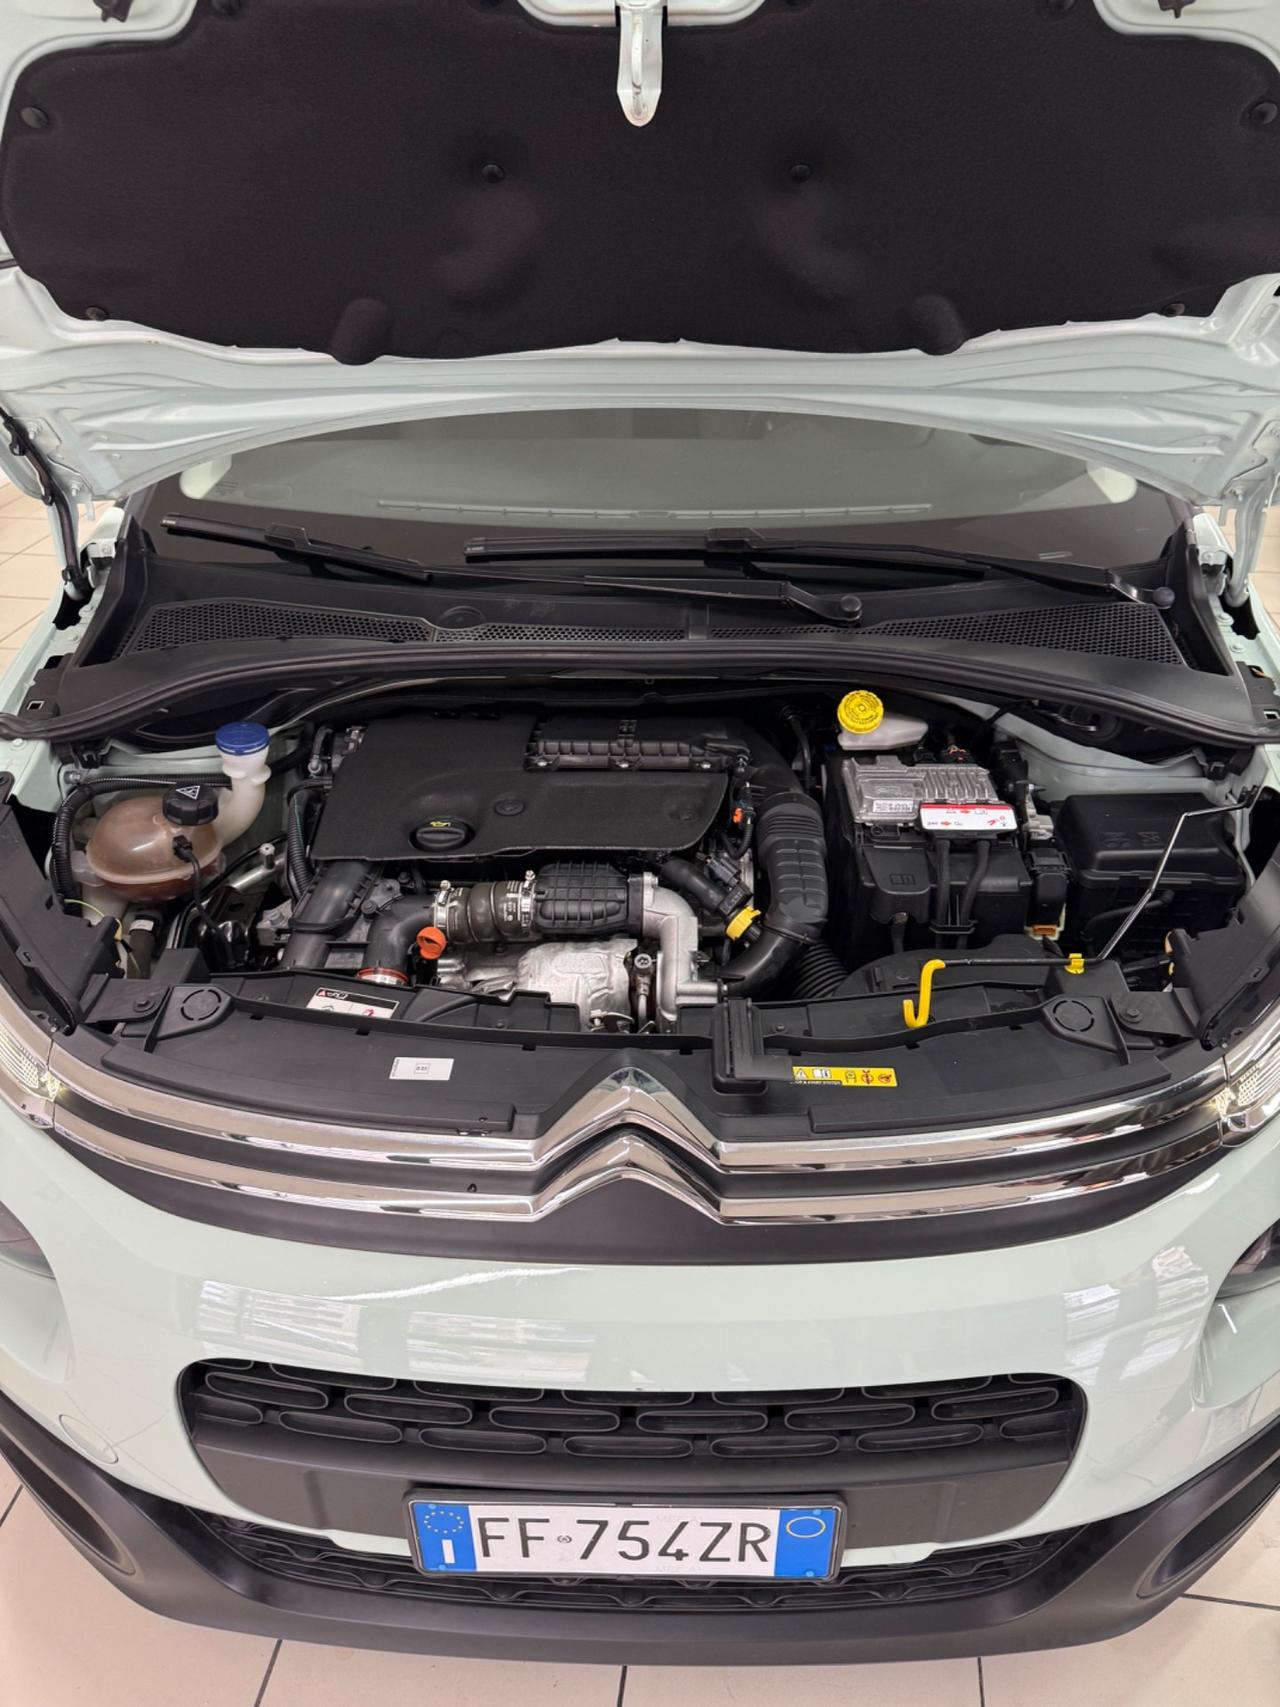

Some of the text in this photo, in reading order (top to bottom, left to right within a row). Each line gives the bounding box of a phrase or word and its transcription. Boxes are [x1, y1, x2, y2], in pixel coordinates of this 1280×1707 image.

[441, 1539, 456, 1564] I
[477, 1517, 771, 1562] FF 754ZR
